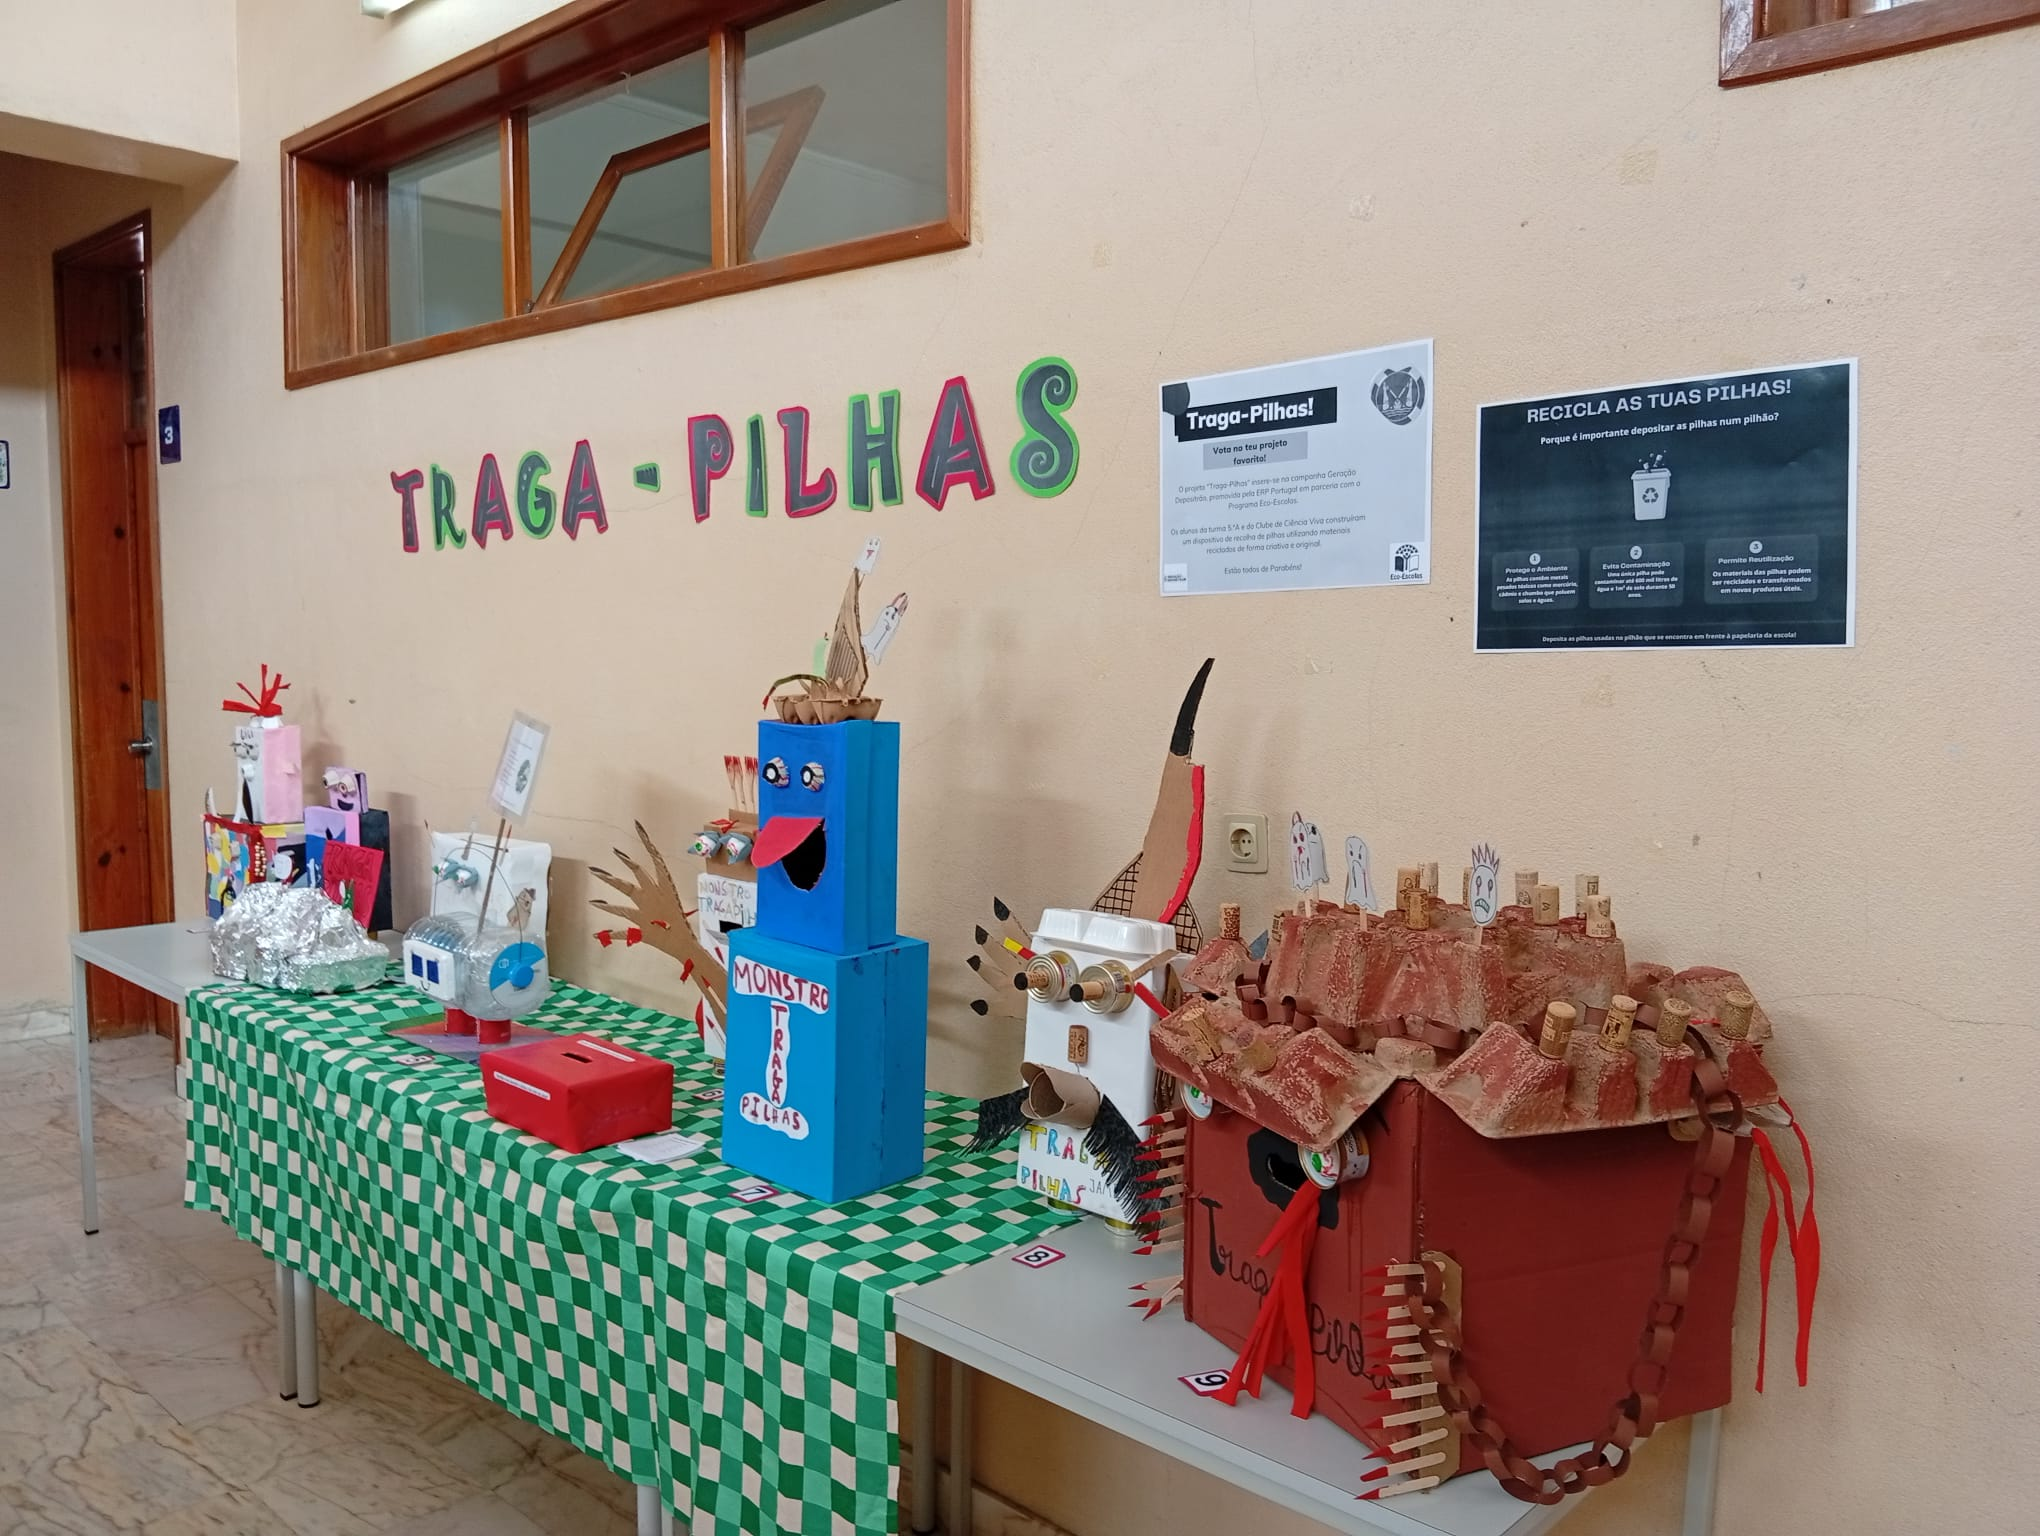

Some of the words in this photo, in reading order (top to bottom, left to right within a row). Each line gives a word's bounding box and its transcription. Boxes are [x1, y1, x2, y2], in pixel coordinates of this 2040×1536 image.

[1527, 400, 1611, 423] RECICLA
[1615, 396, 1642, 413] AS
[1647, 389, 1702, 409] TUAS
[1707, 379, 1792, 402] PILHAS!
[1186, 397, 1314, 431] Traga-Pilhas!
[1540, 434, 1570, 445] Porque
[1572, 433, 1578, 441] é
[1579, 428, 1630, 441] importante
[1631, 423, 1675, 437] depositar
[1676, 423, 1687, 431] as
[1689, 419, 1718, 431] pilhas
[1720, 416, 1742, 426] num
[1743, 412, 1779, 426] pilhão?
[164, 426, 174, 445] 3
[390, 439, 609, 553] TRAGA
[687, 355, 1080, 523] PILHAS
[1212, 446, 1232, 455] Vota
[1245, 443, 1258, 451] teu
[1260, 440, 1288, 452] projeto
[1233, 454, 1266, 465] favorito!
[1291, 472, 1326, 482] campanha
[1328, 469, 1356, 478] Geração
[1270, 486, 1298, 495] Portugal
[1310, 482, 1338, 492] parceria
[1228, 501, 1258, 510] Programa
[1256, 522, 1273, 530] Clube
[1284, 519, 1308, 527] Ciência
[1266, 532, 1286, 540] pilhas
[1286, 530, 1318, 538] utilizando
[1320, 528, 1350, 536] materiais
[1246, 543, 1264, 552] forma
[1266, 542, 1289, 550] criativa
[1620, 561, 1670, 569] Contaminação
[1748, 555, 1794, 563] Reutilização
[1224, 566, 1242, 574] Estão
[1242, 565, 1260, 574] todos
[1390, 572, 1423, 580] Eco-Escolas
[1766, 568, 1787, 576] pilhas
[1788, 568, 1812, 576] podem
[1724, 578, 1756, 586] reciclados
[1762, 576, 1812, 584] transformados
[1752, 586, 1782, 594] produtos
[1624, 634, 1643, 642] pilhão
[1732, 632, 1762, 640] papelaria
[700, 880, 751, 900] MONSTRO
[734, 961, 830, 1012] MONSTRO
[771, 1004, 788, 1105] TRAGA
[741, 1095, 801, 1131] PILHAS
[1021, 1165, 1087, 1205] PILHAS
[741, 1188, 768, 1196] 7
[1024, 1250, 1050, 1263] 8
[1198, 1196, 1276, 1311] Trag
[1194, 1374, 1228, 1387] 9
